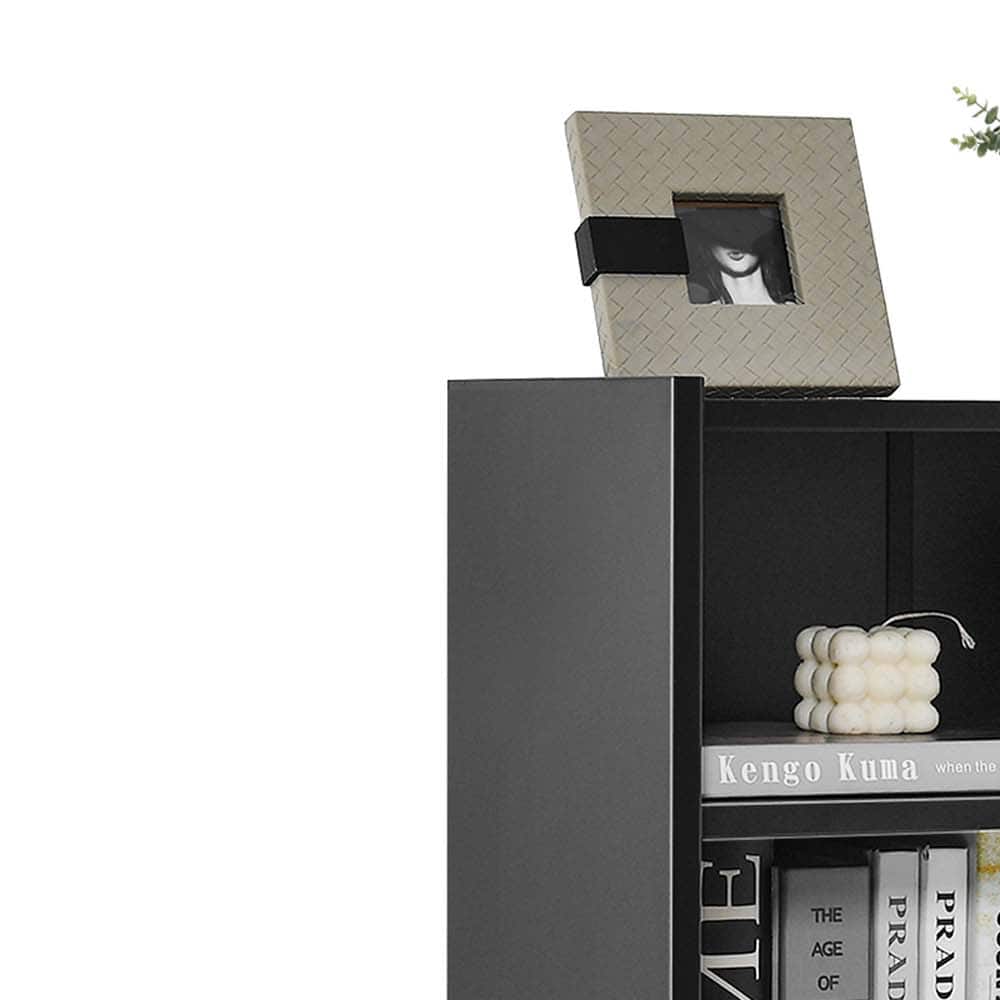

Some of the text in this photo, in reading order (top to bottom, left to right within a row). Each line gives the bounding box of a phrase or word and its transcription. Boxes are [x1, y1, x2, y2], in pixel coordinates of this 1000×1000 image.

[718, 754, 822, 786] Kengo
[838, 752, 919, 782] Kuma
[935, 759, 973, 774] when
[975, 758, 997, 772] the
[811, 907, 842, 923] THE
[811, 941, 843, 957] AGE
[818, 975, 840, 991] OF
